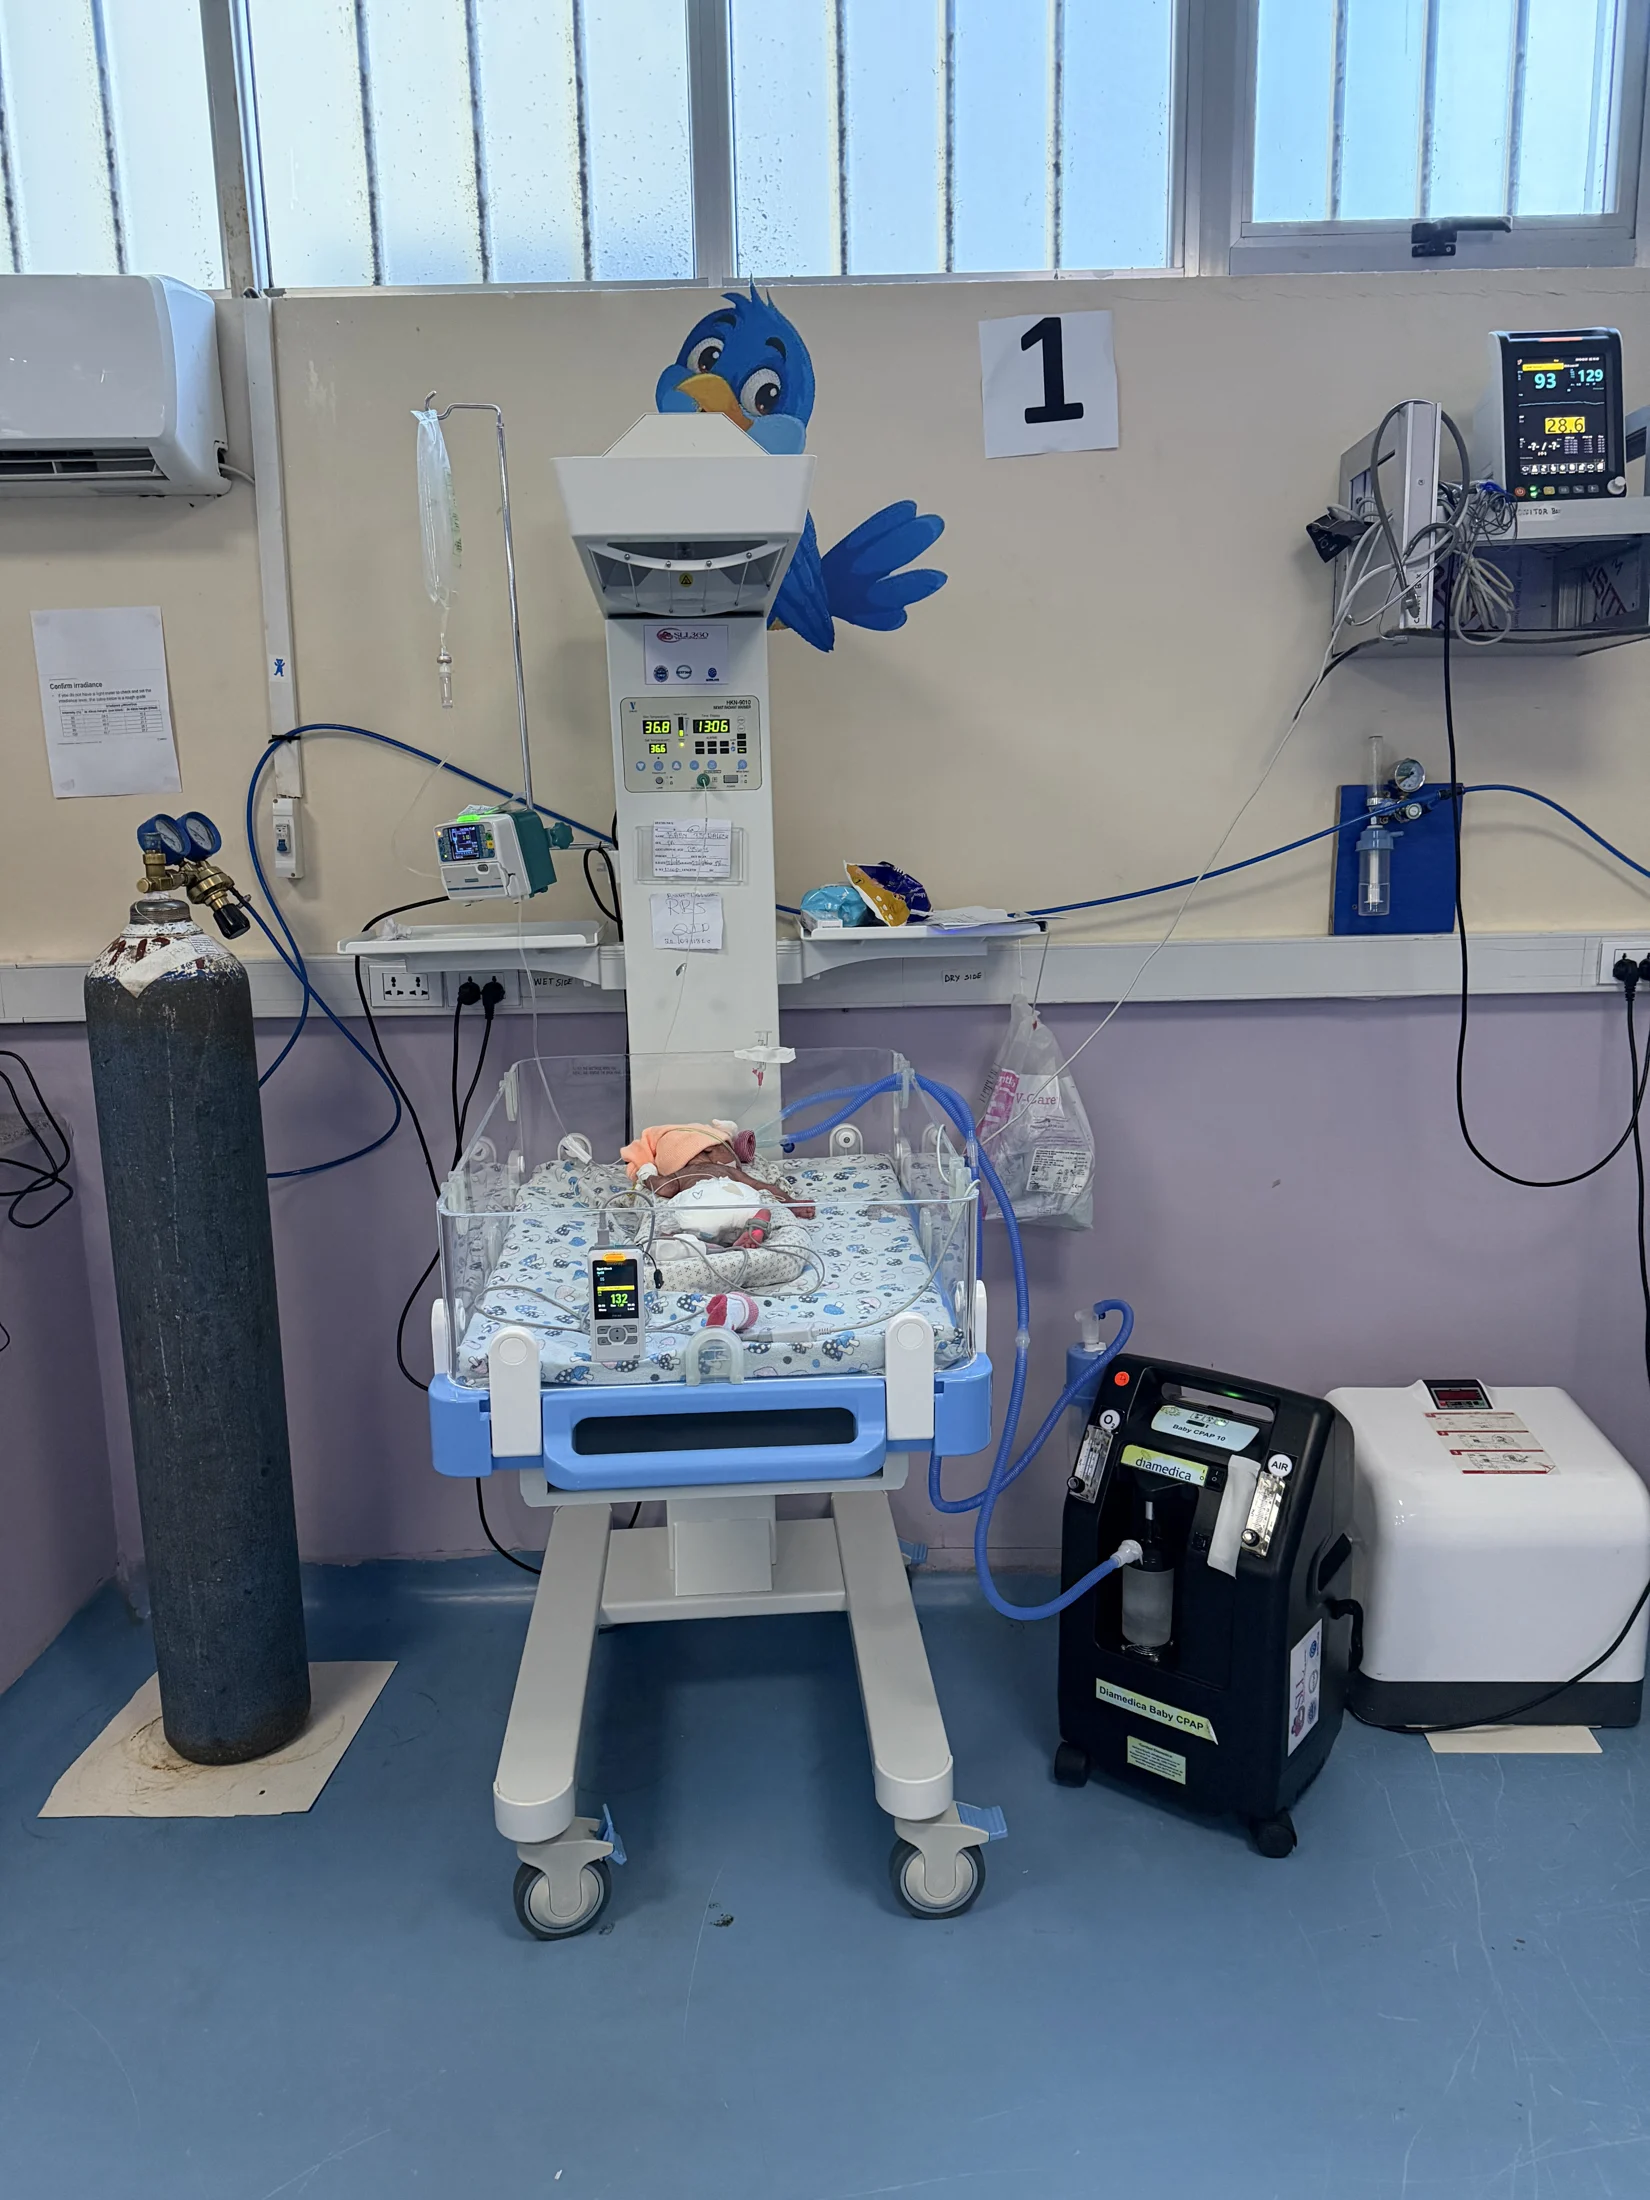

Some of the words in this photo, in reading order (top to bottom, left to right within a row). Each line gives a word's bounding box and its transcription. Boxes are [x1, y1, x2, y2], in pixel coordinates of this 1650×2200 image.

[1021, 317, 1084, 424] 1
[1534, 372, 1557, 390] 93
[1577, 368, 1604, 383] 129
[1547, 417, 1584, 433] 28.6
[50, 682, 73, 690] Confirm
[74, 681, 103, 689] irradiance
[645, 721, 670, 734] 36.8
[650, 745, 666, 753] 36.6
[534, 978, 554, 986] WET
[944, 974, 960, 982] DRY
[964, 972, 982, 981] SIDE
[1016, 1093, 1057, 1106] V-Care
[610, 1293, 628, 1304] 132
[1172, 1424, 1192, 1435] Baby
[1193, 1428, 1216, 1439] CPAP
[1217, 1434, 1226, 1442] 10
[1135, 1457, 1192, 1481] diamedica
[1271, 1461, 1289, 1472] AIR
[1099, 1685, 1147, 1711] Diamedica
[1149, 1705, 1174, 1722] Baby
[1176, 1715, 1204, 1731] CPAP
